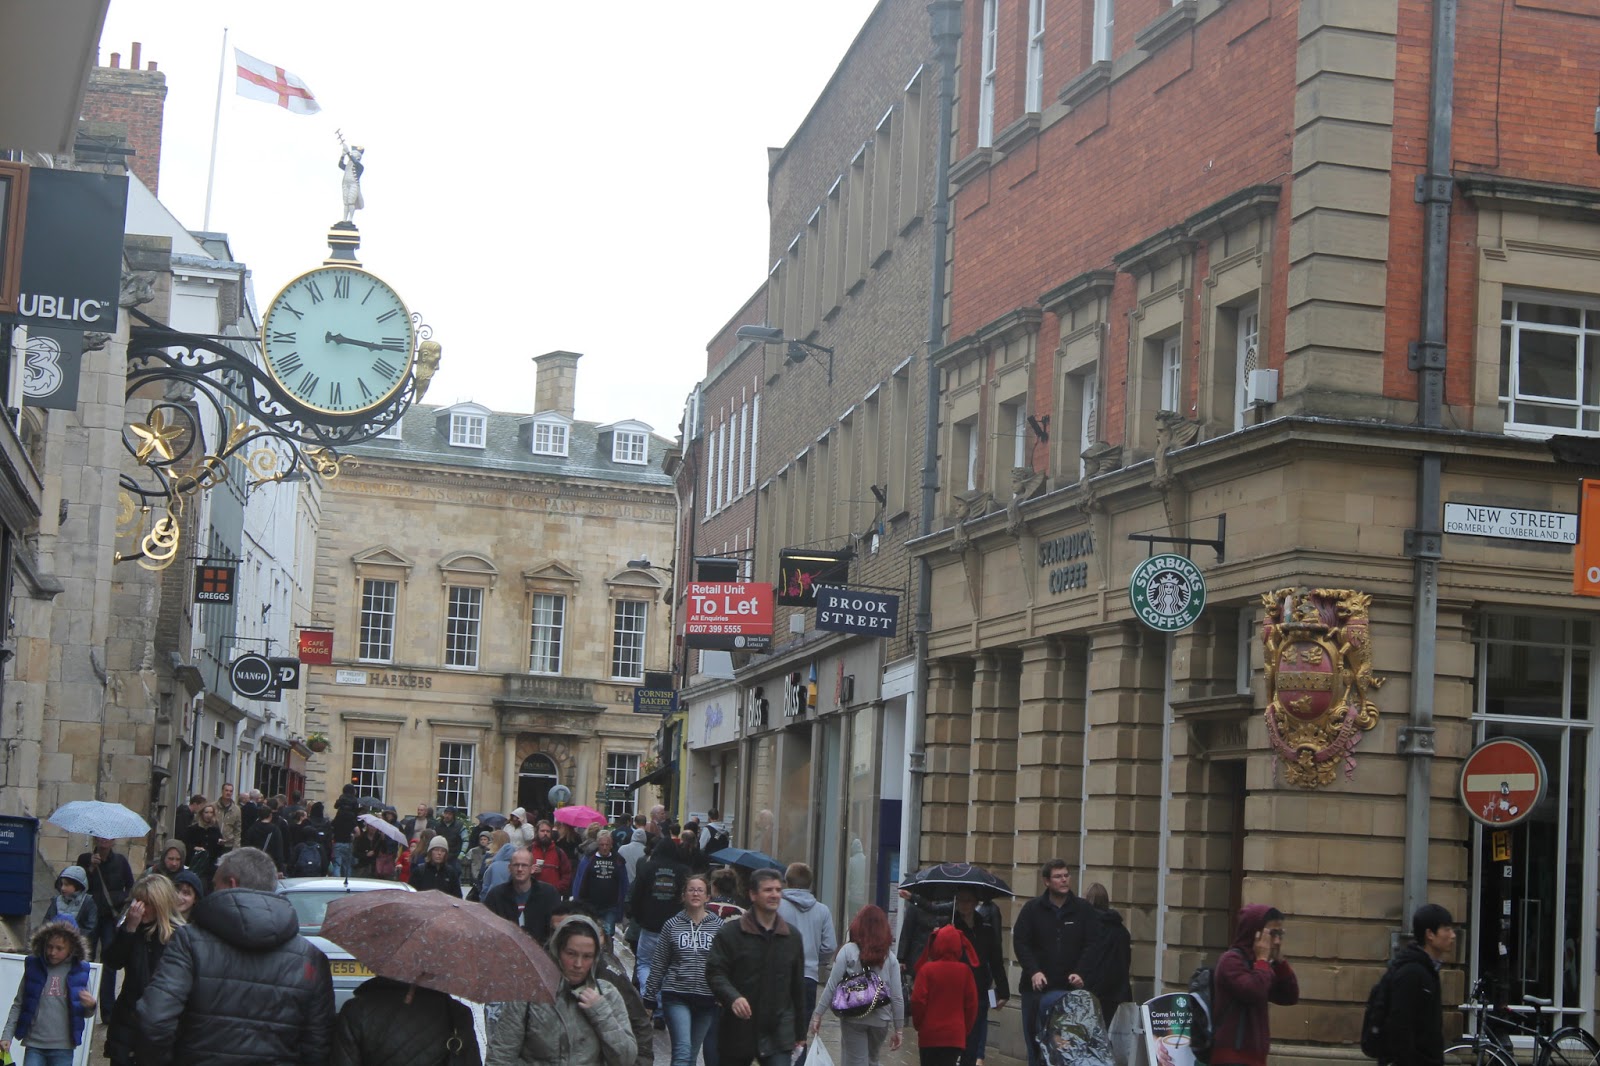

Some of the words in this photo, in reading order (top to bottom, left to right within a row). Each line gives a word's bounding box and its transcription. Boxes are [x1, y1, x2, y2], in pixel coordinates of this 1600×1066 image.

[304, 280, 324, 305] XI
[334, 276, 350, 299] XII
[17, 294, 101, 322] UBLIC
[282, 302, 304, 320] X
[273, 331, 296, 343] IX
[276, 352, 303, 377] VIII
[358, 377, 372, 399] V
[1466, 508, 1500, 523] NEW
[1510, 512, 1565, 529] STREET
[1447, 522, 1494, 534] FORMERLY
[1499, 526, 1559, 540] CUMBERLAND
[1563, 532, 1575, 541] RO
[1039, 529, 1093, 567] STARBUCK
[1048, 562, 1088, 595] COFFEE
[1136, 557, 1202, 592] STARBUCKS
[198, 592, 230, 600] GREGGS
[692, 585, 720, 594] Retail
[724, 585, 745, 594] Unit
[691, 596, 717, 614] To
[724, 596, 758, 615] Let
[829, 596, 887, 613] BROOK
[820, 611, 892, 629] STREET
[1142, 606, 1193, 628] COFFEE
[690, 625, 707, 633] 0207
[709, 625, 722, 633] 399
[723, 625, 741, 633] 5555
[236, 671, 267, 680] MANGO
[638, 690, 674, 698] CORNISH
[0, 829, 14, 838] artin
[678, 931, 715, 950] GAP
[1152, 1018, 1178, 1026] stronger,
